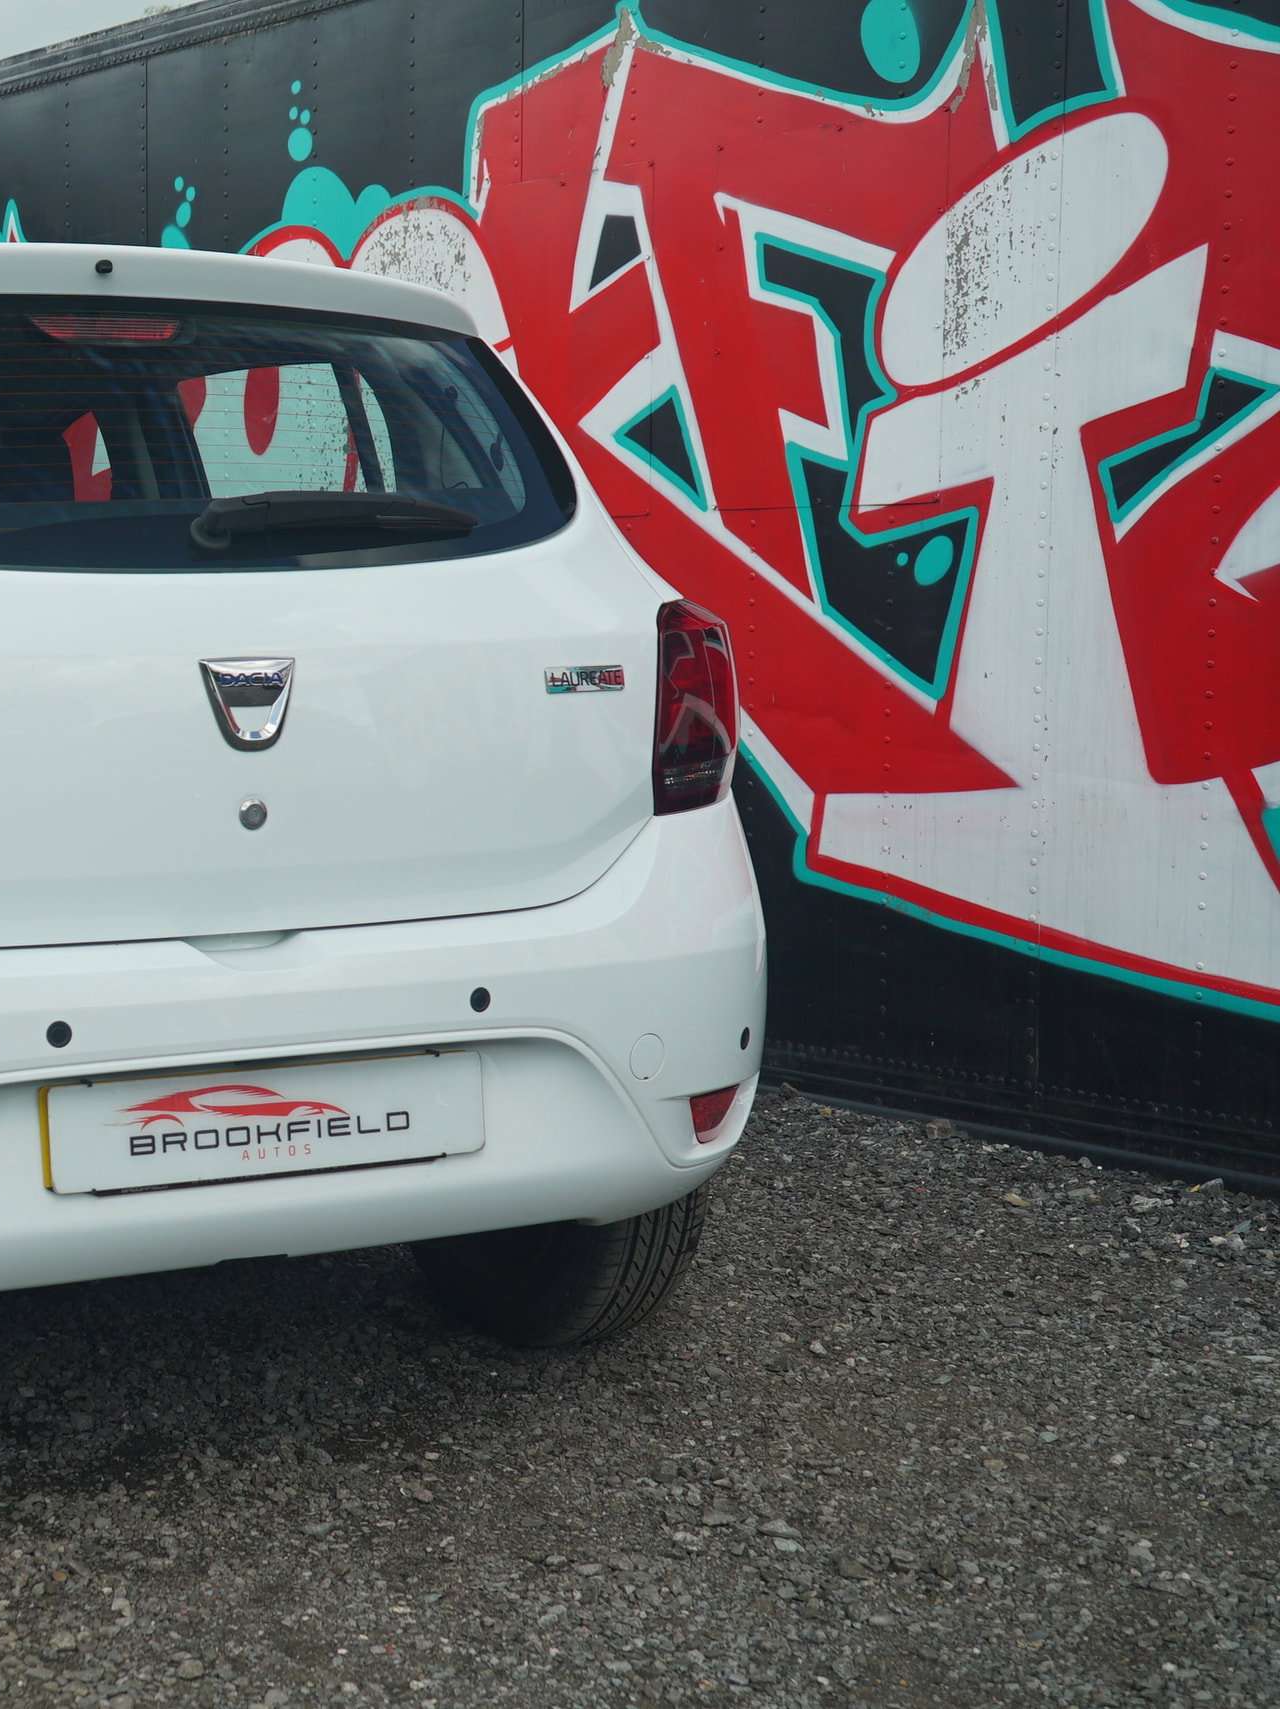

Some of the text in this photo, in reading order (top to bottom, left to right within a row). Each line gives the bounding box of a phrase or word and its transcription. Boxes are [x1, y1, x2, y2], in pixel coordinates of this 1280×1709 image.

[219, 671, 284, 687] DACIA
[549, 668, 624, 687] LAUREATE
[129, 1110, 411, 1157] BROOKFIELD
[241, 1143, 312, 1161] AUTOS
